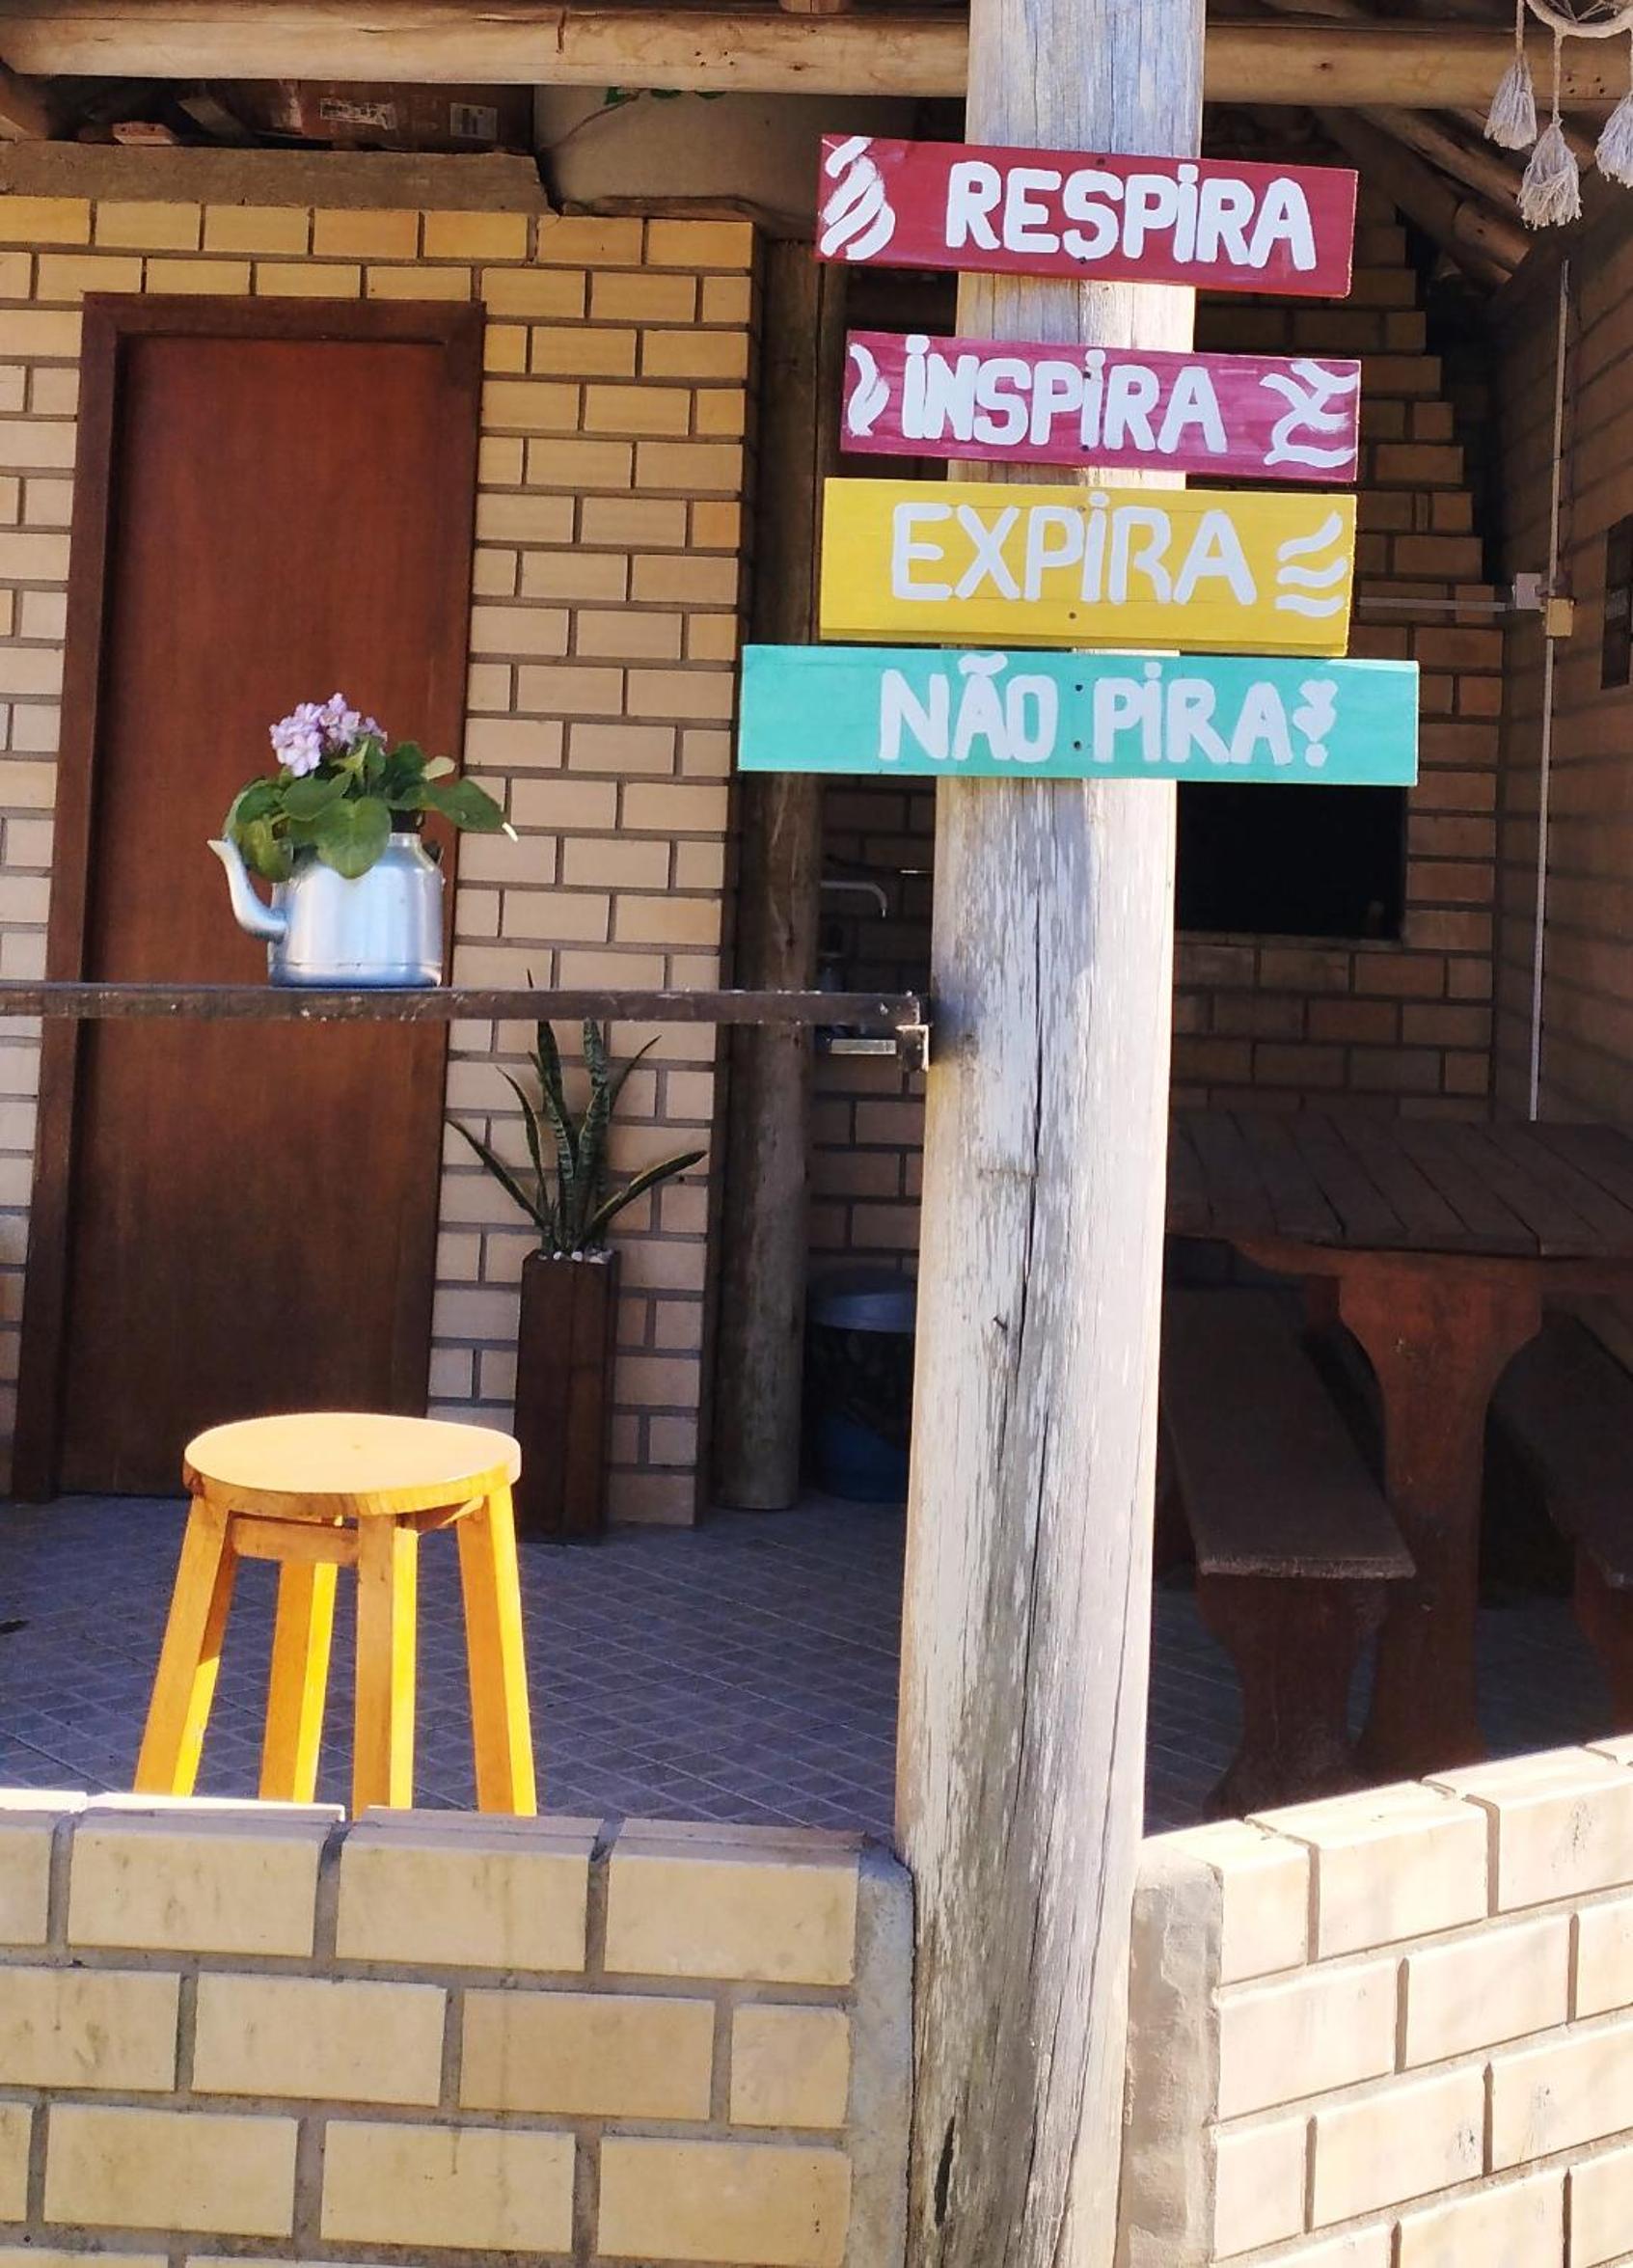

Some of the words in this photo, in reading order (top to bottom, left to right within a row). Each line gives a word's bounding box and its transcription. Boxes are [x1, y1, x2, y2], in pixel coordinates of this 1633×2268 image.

[945, 161, 1317, 271] RESPIRA
[901, 335, 1228, 454] INSPIRA
[890, 492, 1258, 606] EXPIRA
[879, 652, 1060, 763] NÃO
